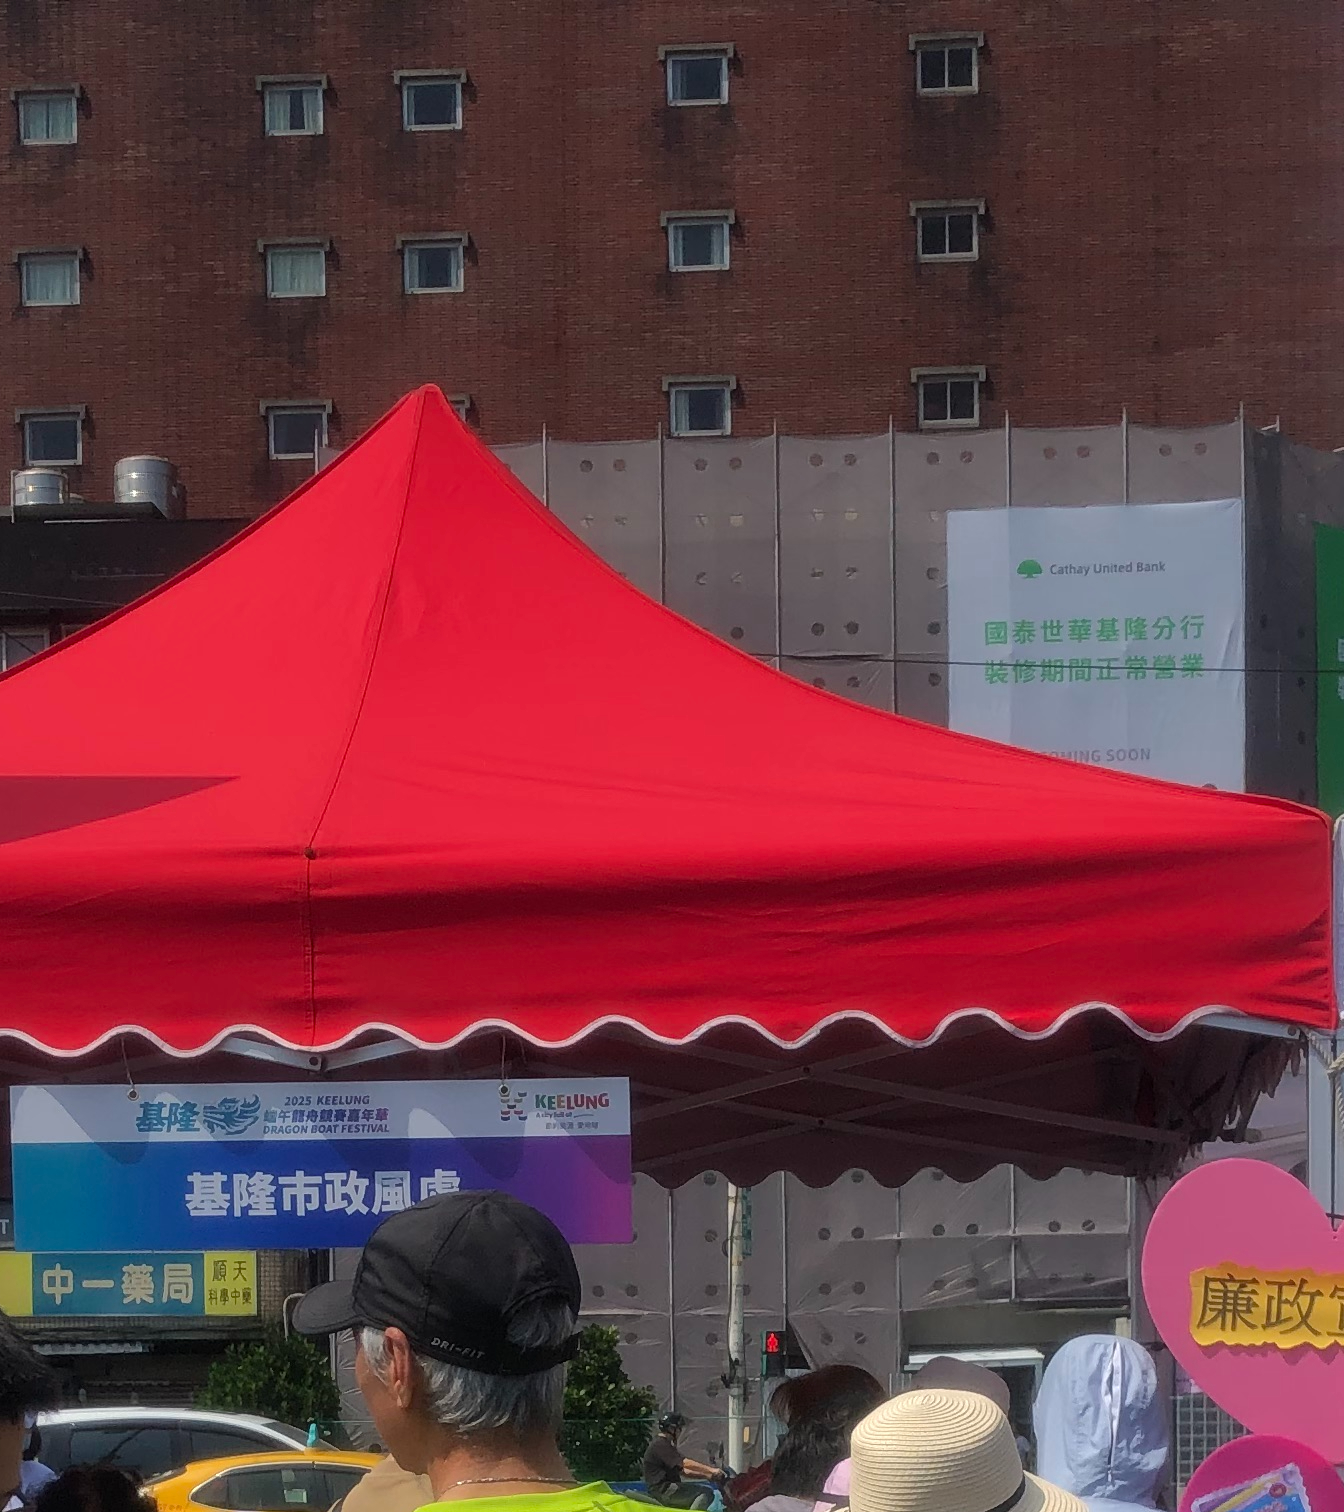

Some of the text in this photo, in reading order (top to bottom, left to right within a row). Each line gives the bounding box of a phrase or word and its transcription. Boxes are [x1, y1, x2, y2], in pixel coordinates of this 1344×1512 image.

[1049, 560, 1166, 577] Cathay United Bank
[984, 615, 1205, 646] 國泰世華基隆分行
[984, 653, 1204, 685] 裝修期間正常營業
[1043, 748, 1151, 764] OMING SOON
[284, 1094, 371, 1107] 2025 KEELUNG
[534, 1092, 611, 1111] KEELUNG
[135, 1101, 201, 1133] 基隆
[262, 1123, 391, 1135] DRAGON BOAT FESTIVAL
[211, 1259, 248, 1282] 順天
[42, 1262, 195, 1306] 中一藥局
[207, 1287, 253, 1307] 科學中藥
[430, 1336, 486, 1360] DRI-FIT
